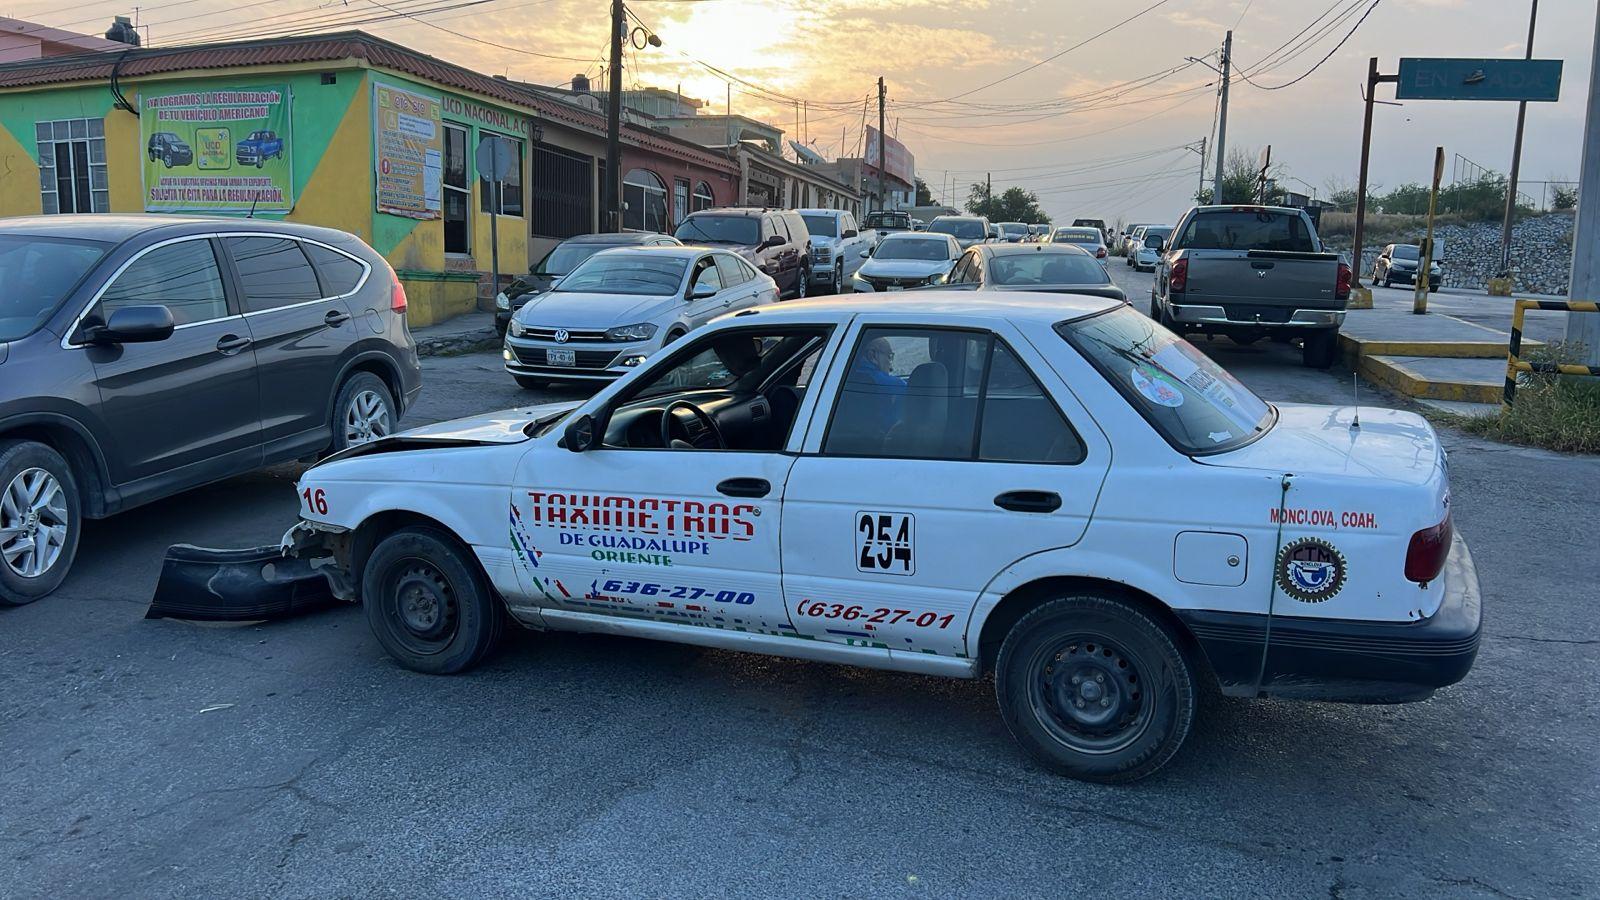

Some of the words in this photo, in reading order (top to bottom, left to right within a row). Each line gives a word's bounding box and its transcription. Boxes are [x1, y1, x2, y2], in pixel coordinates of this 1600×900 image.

[160, 94, 201, 107] LOGRAMOS
[202, 93, 213, 105] LA
[213, 91, 281, 104] REGULARIZACIÓN
[442, 95, 462, 115] UCD
[159, 110, 169, 120] DE
[170, 110, 180, 120] TU
[181, 107, 218, 121] VEHÍCULO
[219, 106, 269, 120] AMERICANO!
[187, 188, 201, 201] CITA
[201, 189, 218, 201] PARA
[219, 189, 227, 201] LA
[303, 487, 328, 515] 16
[528, 492, 754, 541] TAXIMETROS
[1341, 511, 1378, 529] COAH.
[560, 532, 585, 546] DE
[588, 534, 709, 555] GUADALUPE
[859, 514, 911, 571] 254
[591, 550, 673, 567] ORIENTE
[1293, 546, 1331, 562] CTM
